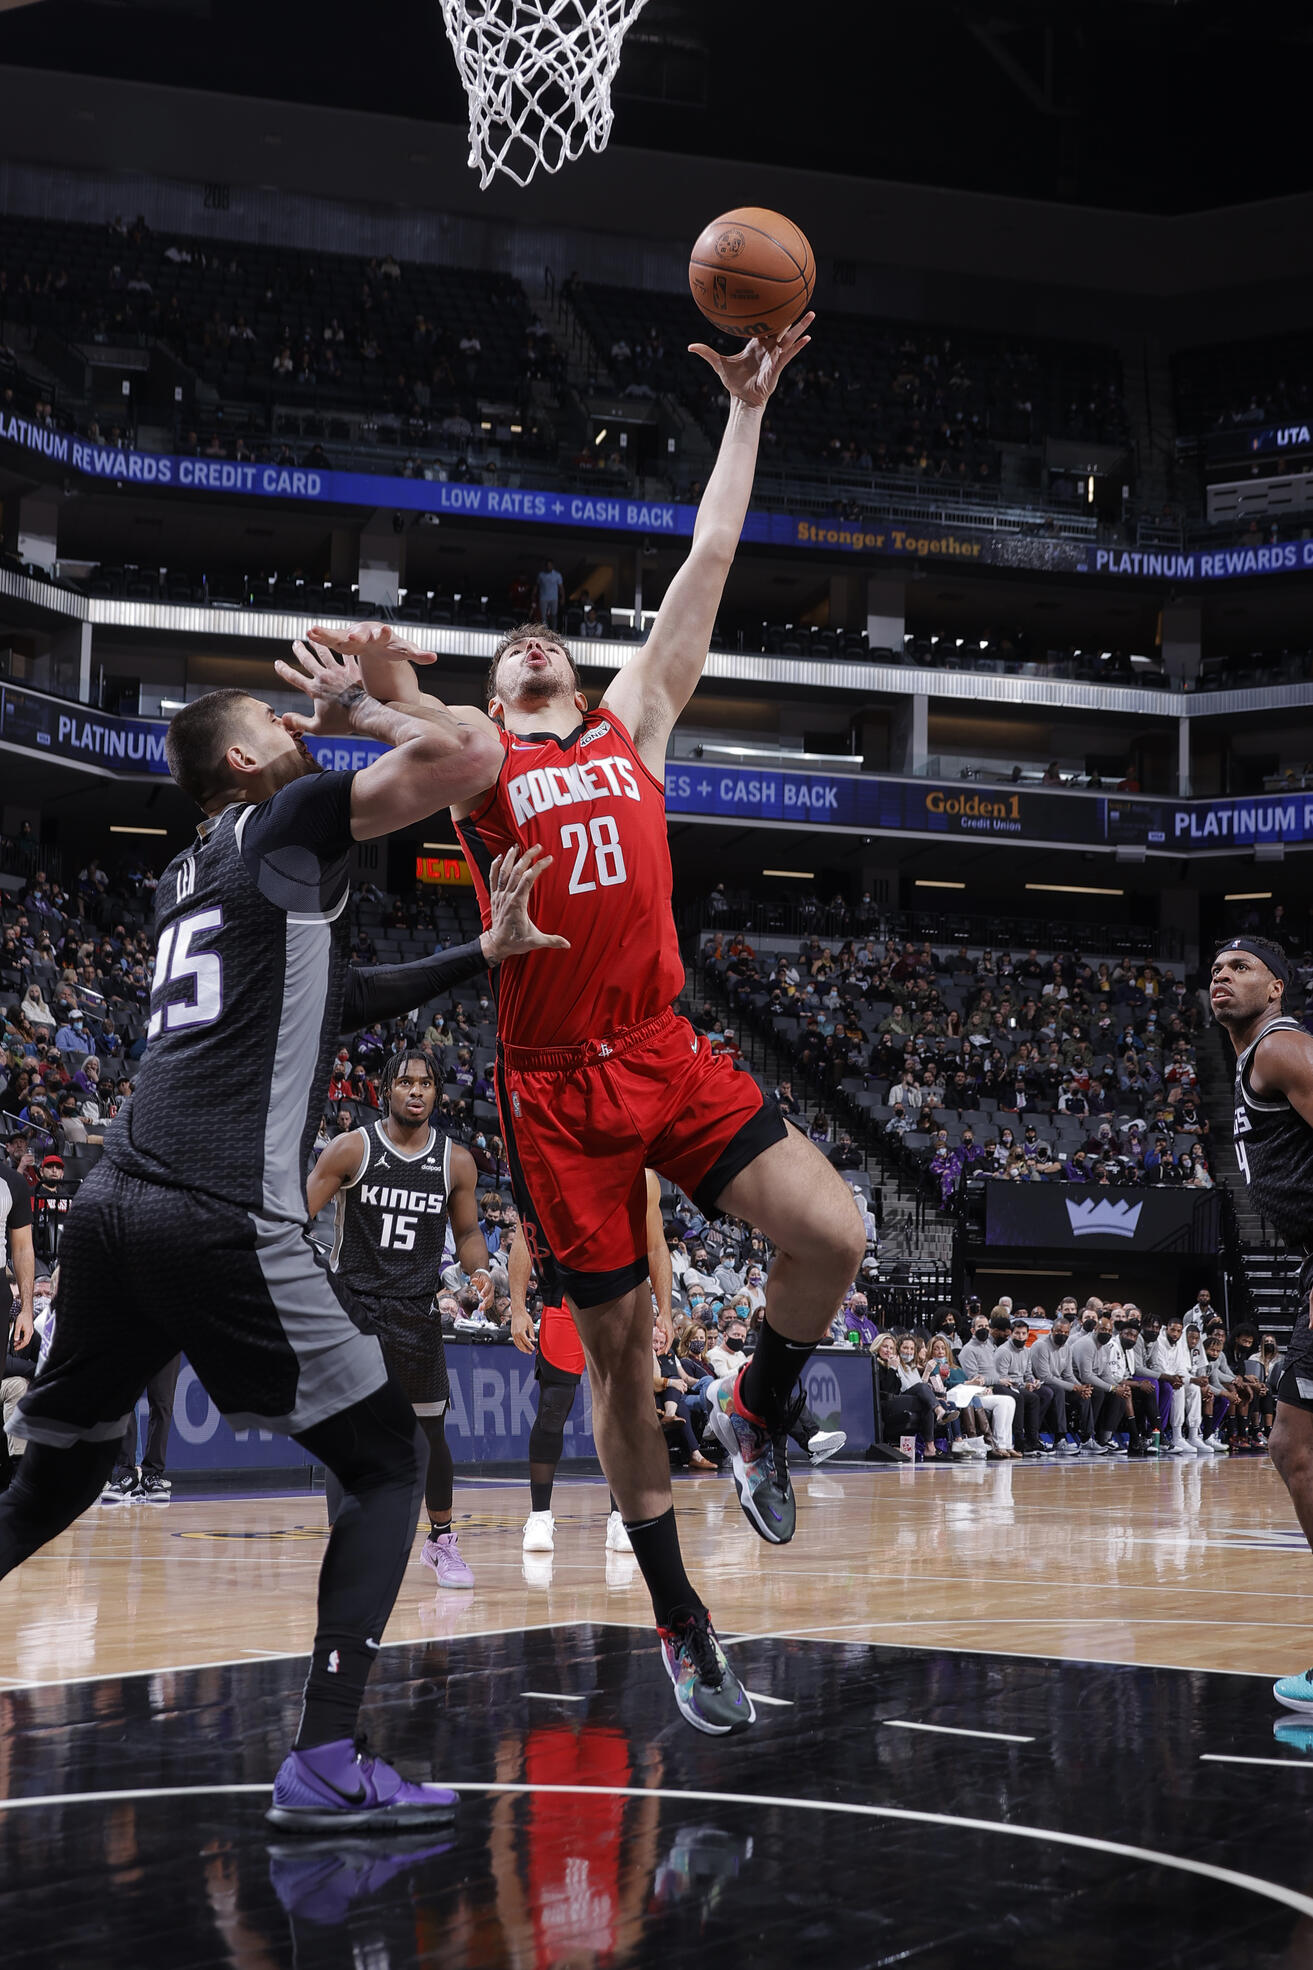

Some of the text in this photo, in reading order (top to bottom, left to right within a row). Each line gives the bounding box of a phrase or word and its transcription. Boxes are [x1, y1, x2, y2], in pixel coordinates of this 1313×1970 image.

[1276, 426, 1310, 446] UTA
[73, 443, 171, 482] REWARDS
[179, 461, 257, 490] CREDIT
[263, 469, 321, 496] CARD
[441, 487, 674, 528] LOW RATES + CASH BACK
[797, 522, 981, 556] Stronger Together
[1096, 549, 1195, 578] PLATINUM
[1201, 543, 1297, 577] REWARDS
[58, 715, 166, 763] PLATINUM
[507, 755, 641, 827] ROCKETS
[720, 779, 776, 804] CASH
[783, 783, 838, 809] BACK
[961, 816, 1021, 832] Credit Union
[1174, 806, 1296, 837] PLATINUM
[560, 815, 628, 895] 28
[360, 1184, 444, 1214] KINGS
[380, 1213, 418, 1250] 15
